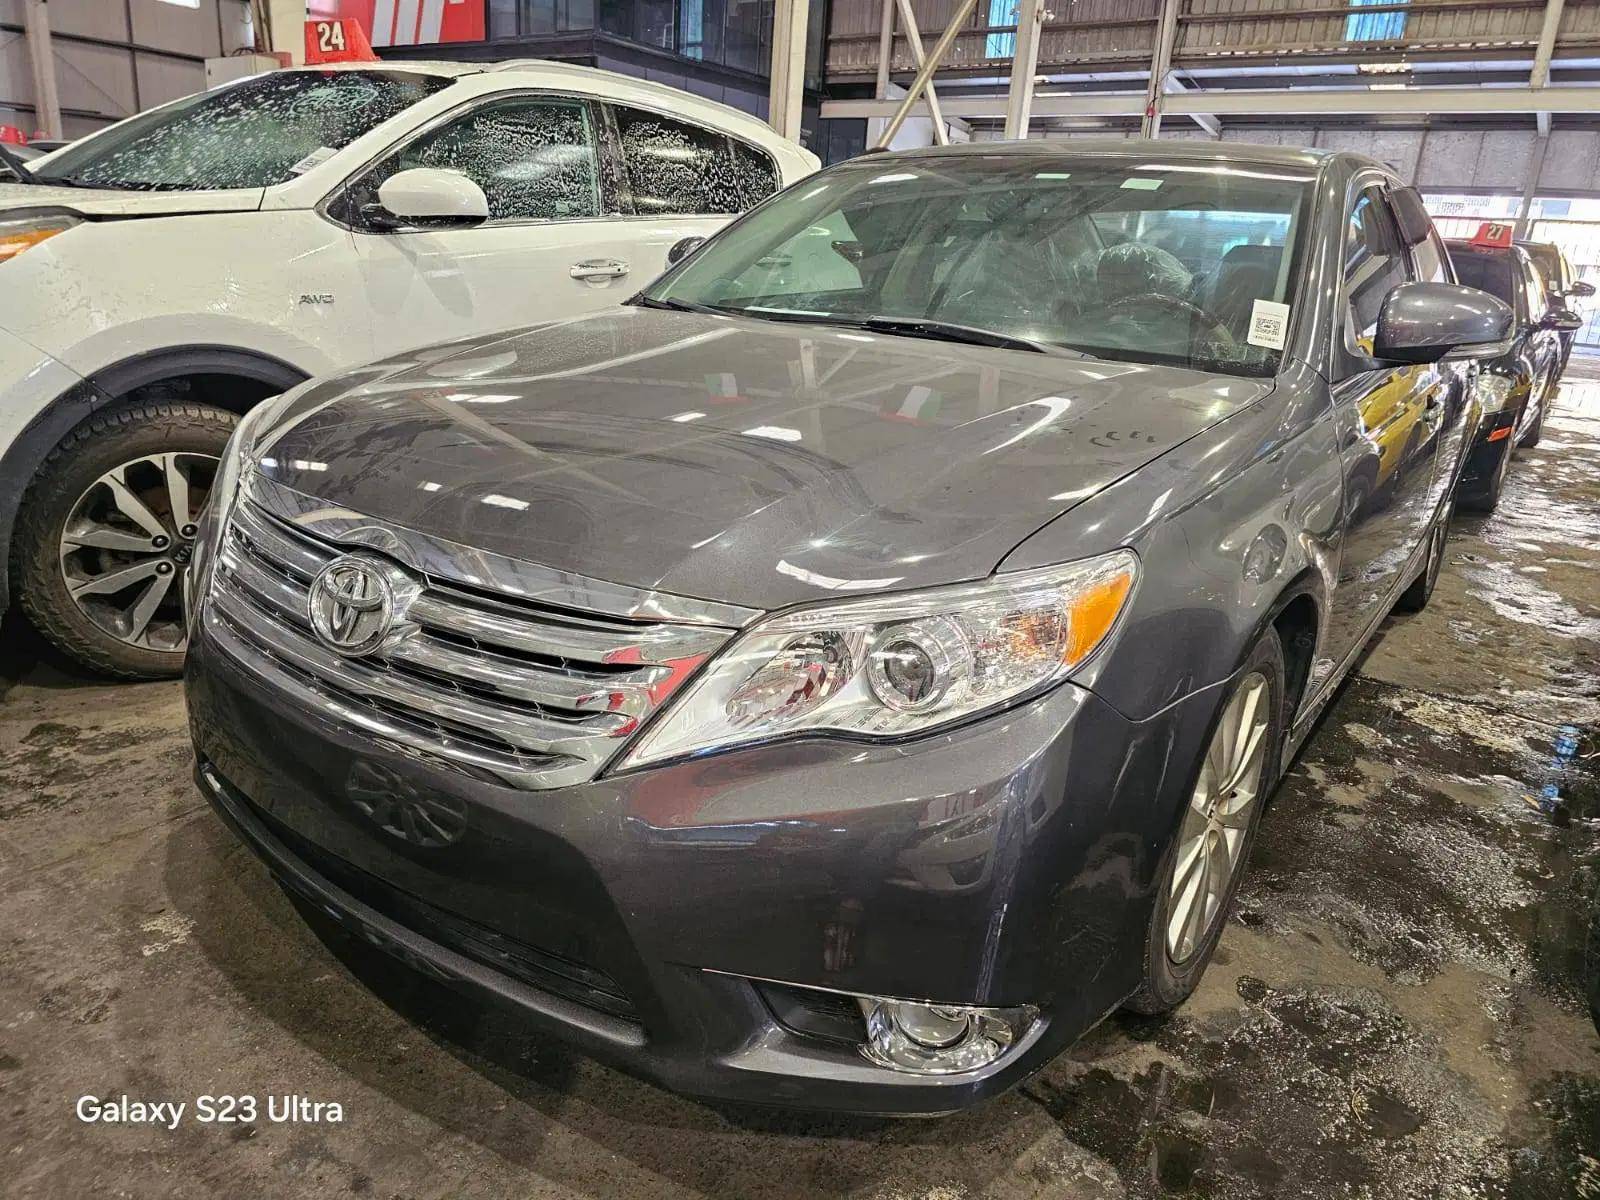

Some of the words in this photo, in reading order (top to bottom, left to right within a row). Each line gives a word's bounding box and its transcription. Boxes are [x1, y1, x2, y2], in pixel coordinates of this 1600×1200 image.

[318, 21, 345, 52] 24
[1487, 224, 1504, 240] 27
[298, 294, 335, 305] AWD
